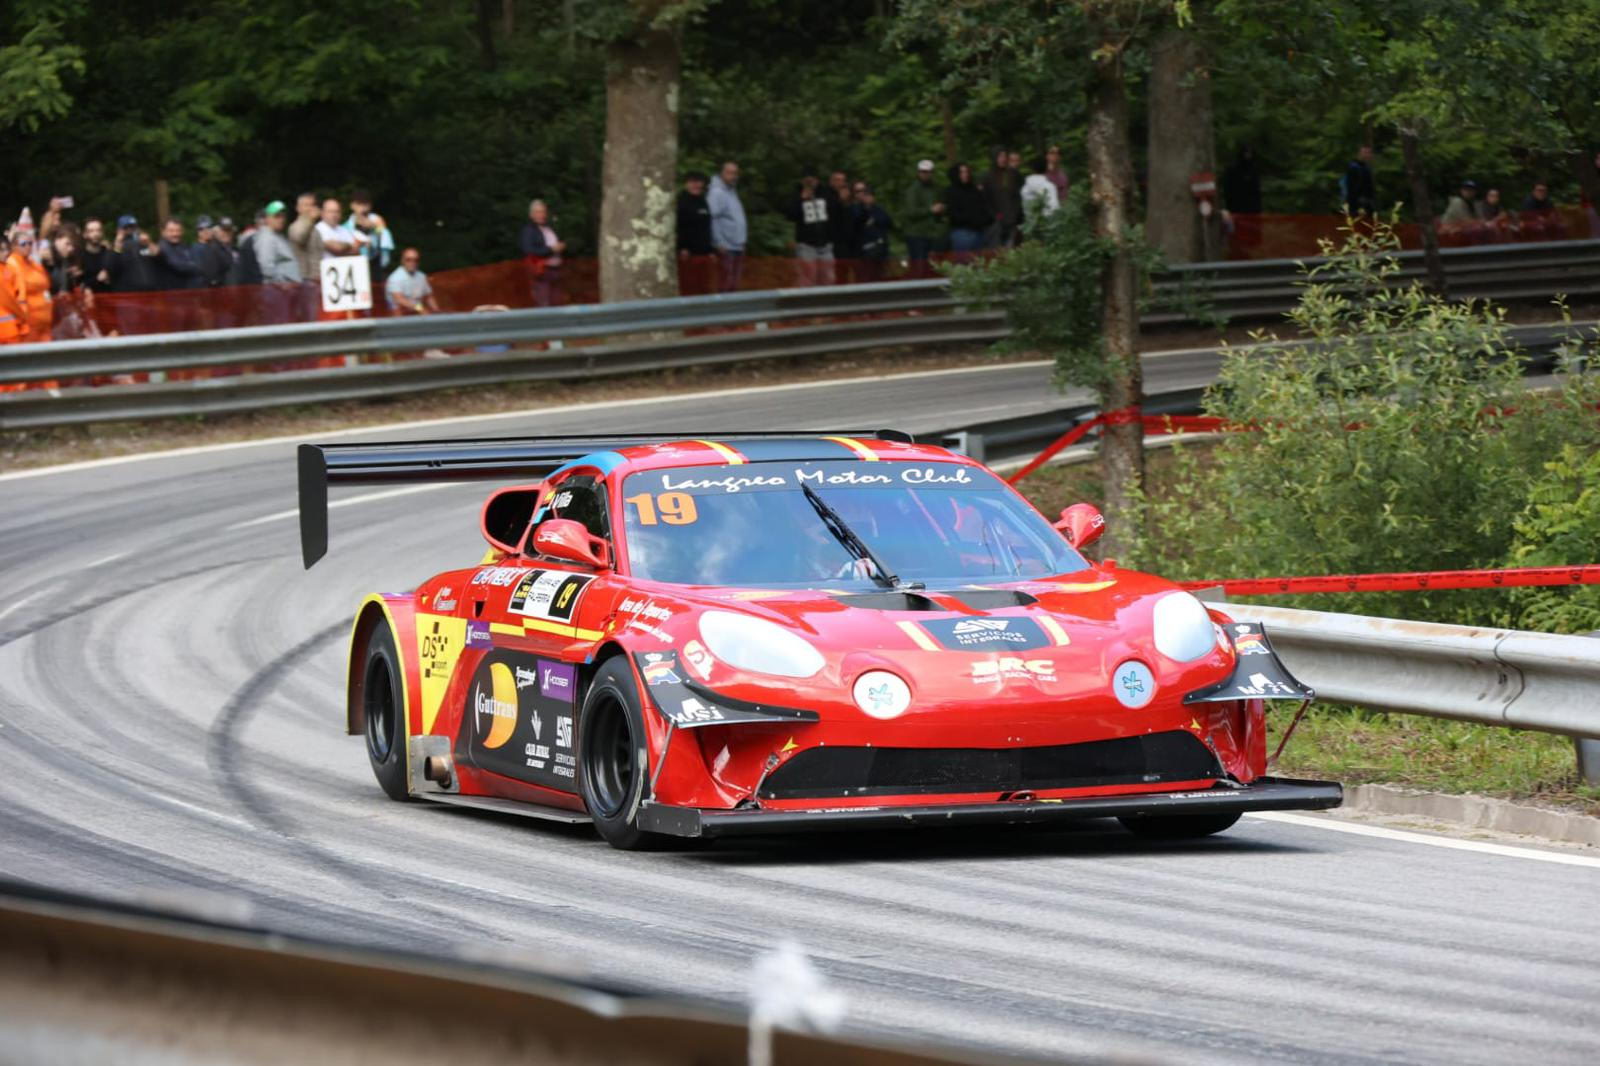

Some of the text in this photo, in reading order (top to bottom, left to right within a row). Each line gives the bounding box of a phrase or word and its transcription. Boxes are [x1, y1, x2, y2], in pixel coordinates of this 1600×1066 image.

[327, 265, 356, 304] 34
[661, 468, 973, 493] Langreo Motor Club
[625, 492, 699, 526] 19
[422, 635, 438, 659] DS
[955, 631, 1025, 641] SERVICIOS
[959, 636, 1028, 646] INTEGRALES
